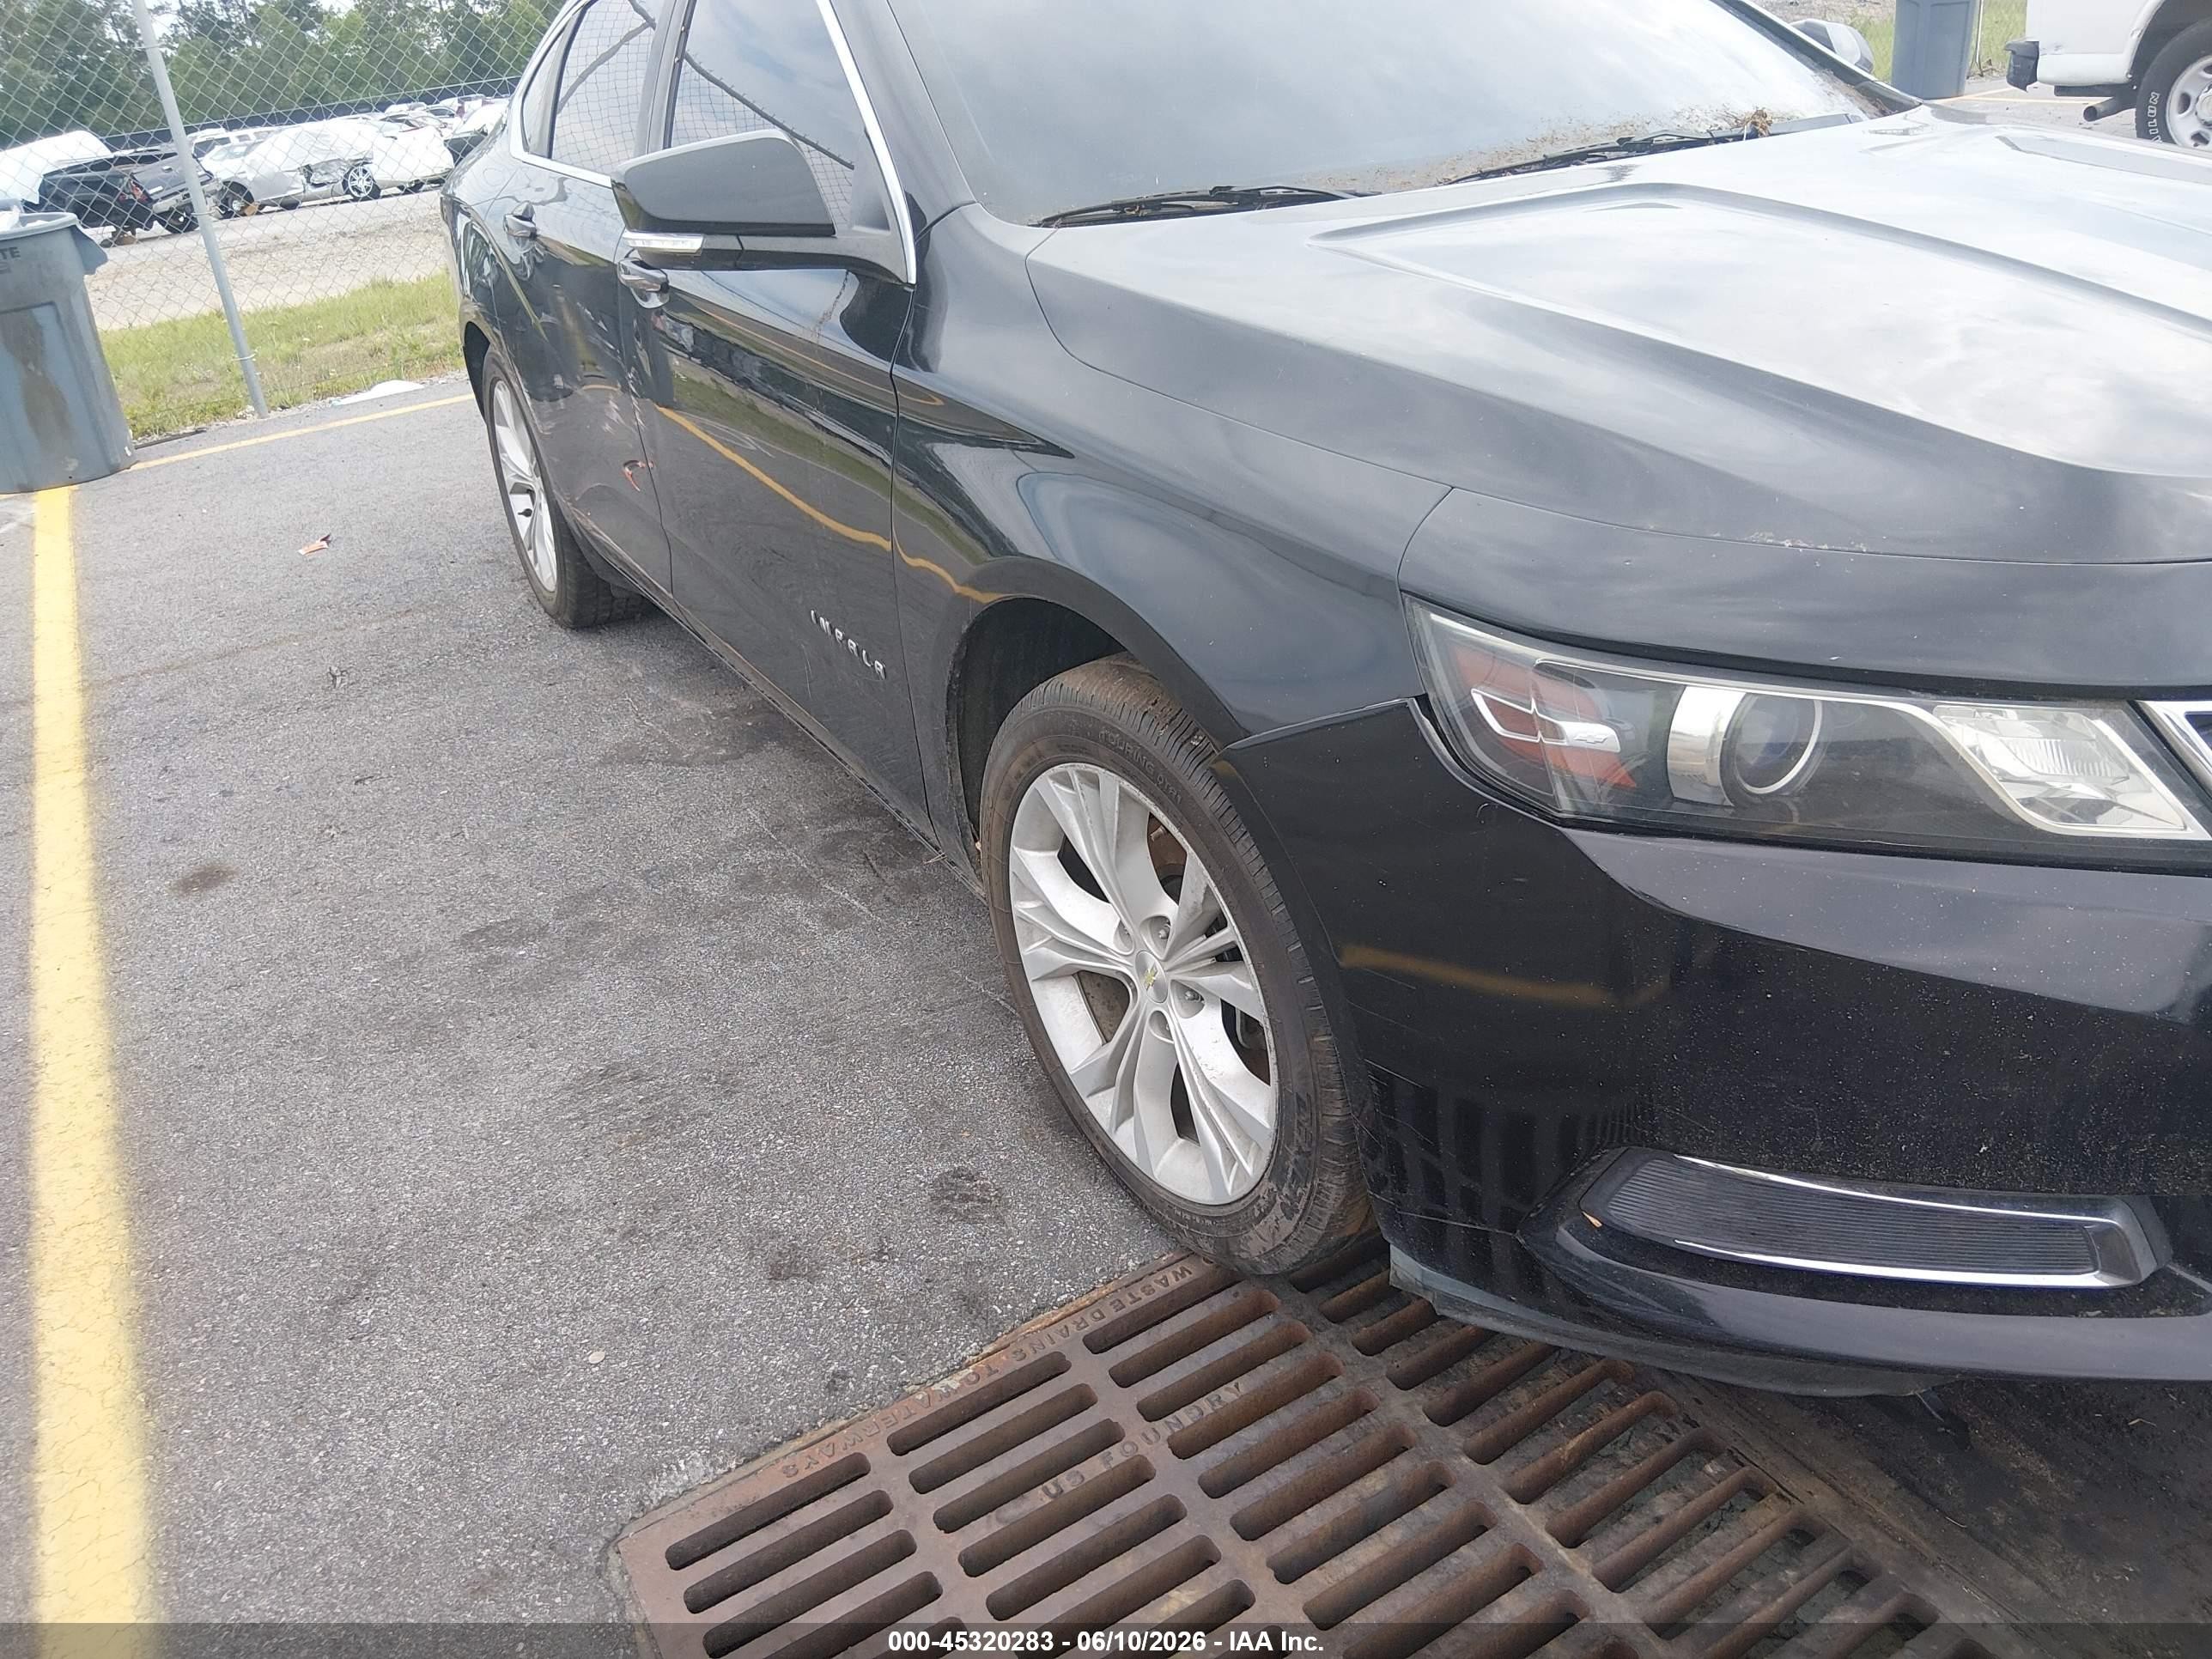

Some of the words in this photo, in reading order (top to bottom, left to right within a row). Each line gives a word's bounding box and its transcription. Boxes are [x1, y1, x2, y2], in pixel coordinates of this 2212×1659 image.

[810, 610, 886, 680] IMPALA
[1109, 1265, 1193, 1313] WASTE
[1012, 1308, 1106, 1362] DRAINS
[960, 1362, 1000, 1386] TO
[782, 1379, 960, 1477] WATERWAYS
[1041, 1470, 1086, 1499] US
[1099, 1381, 1243, 1470] FOUNDRY
